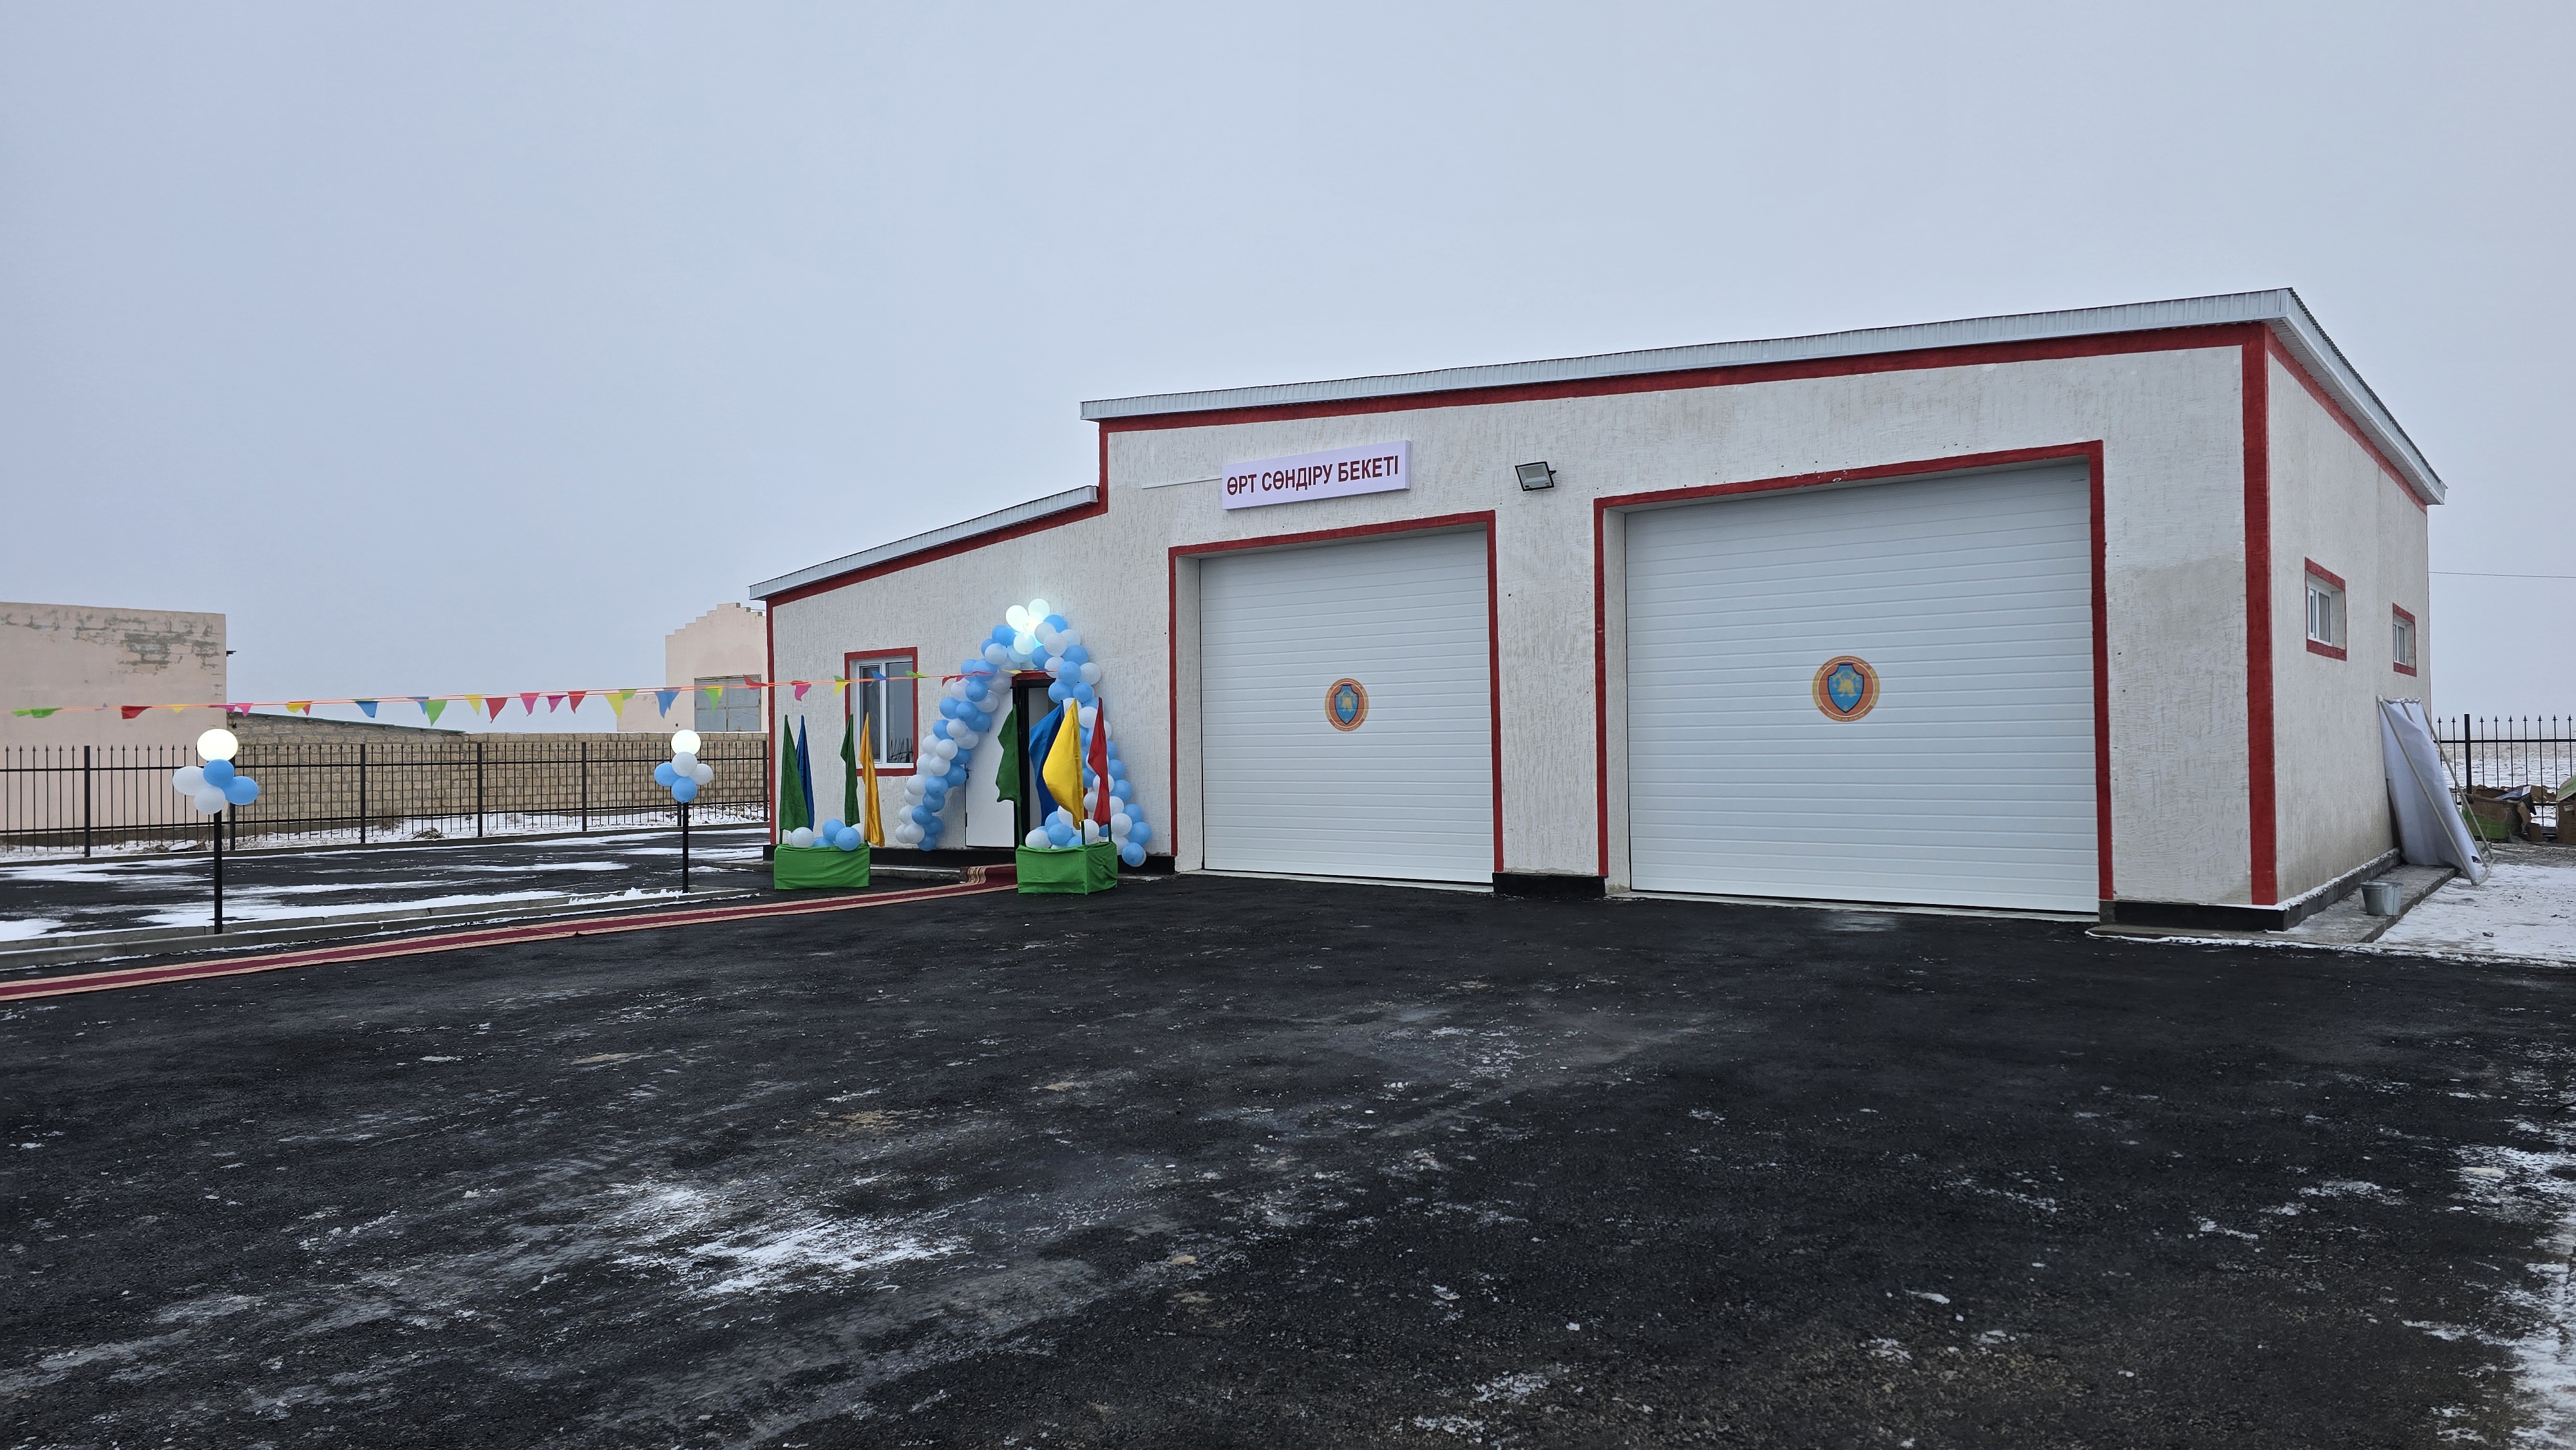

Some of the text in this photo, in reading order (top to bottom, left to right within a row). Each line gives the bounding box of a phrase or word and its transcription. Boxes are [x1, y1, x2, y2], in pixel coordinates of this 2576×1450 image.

[1227, 455, 1399, 496] ӨРТ СӨНДІРУ БЕКЕТІ
